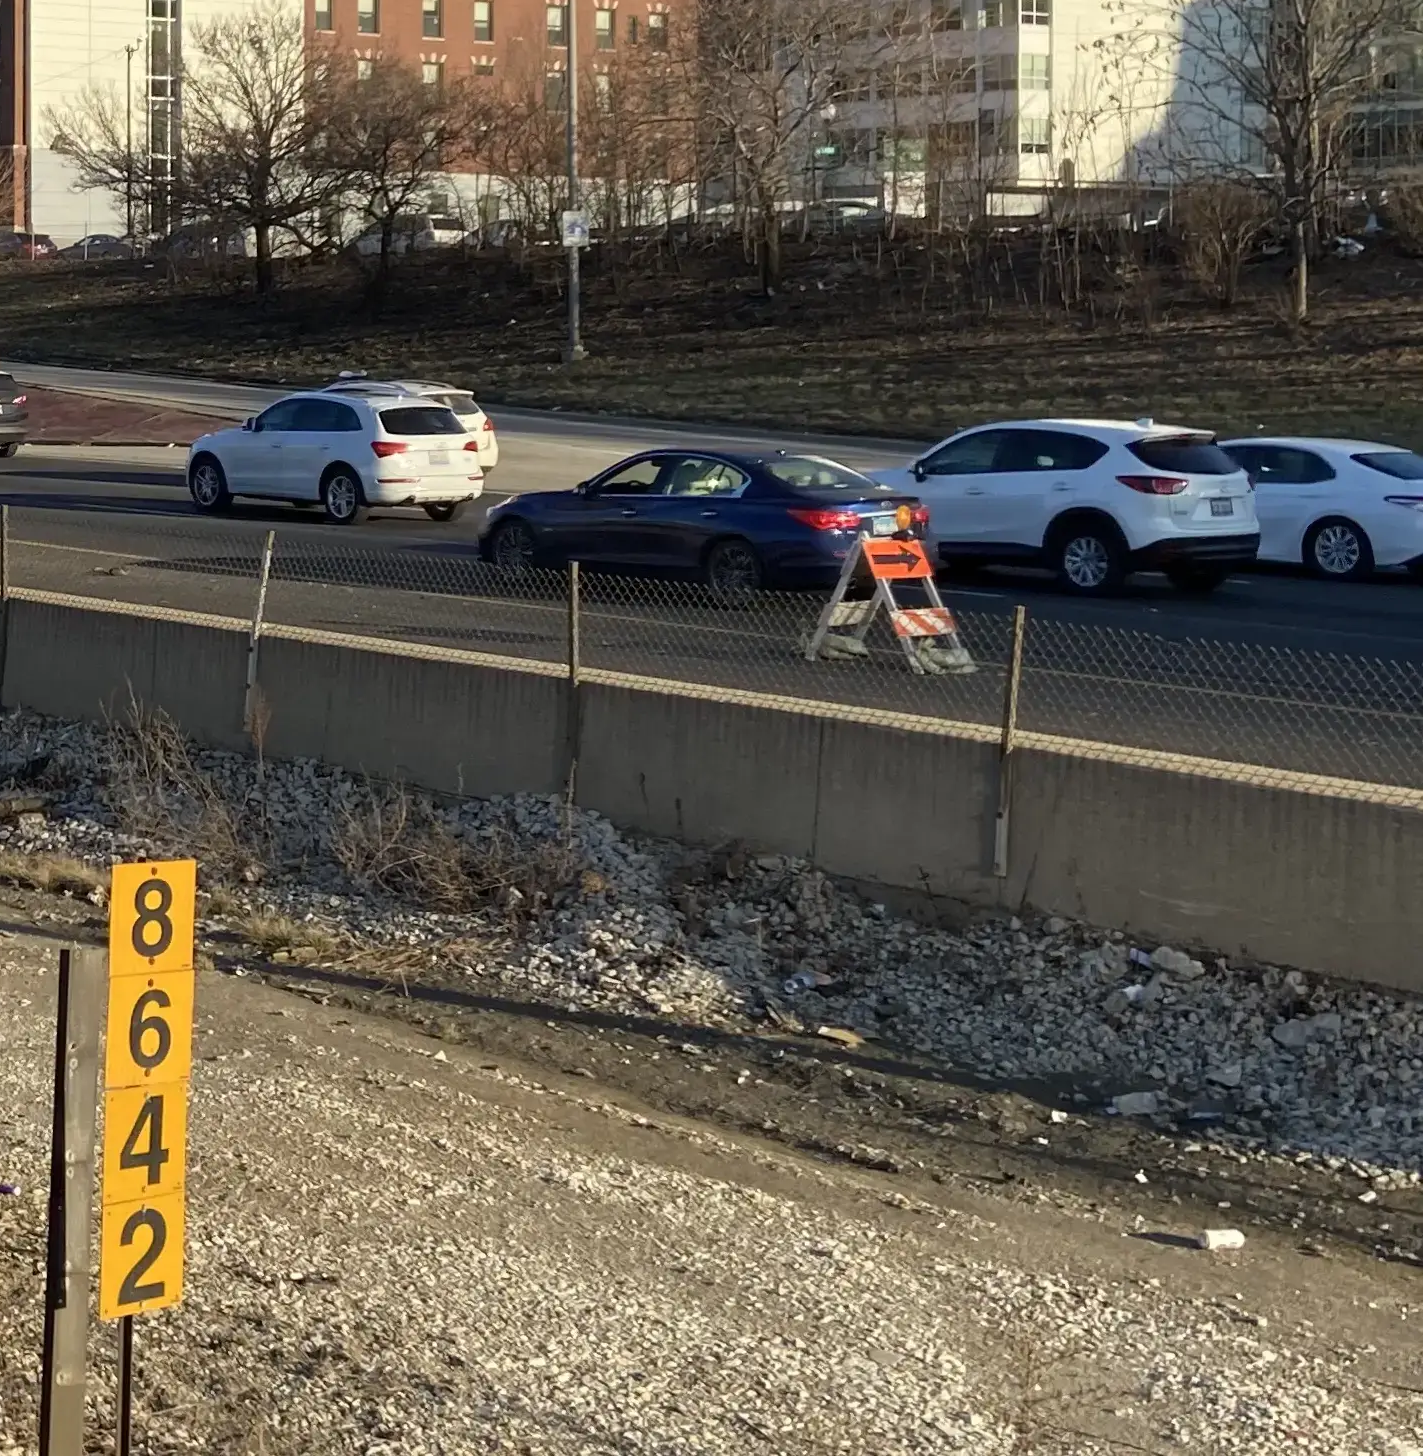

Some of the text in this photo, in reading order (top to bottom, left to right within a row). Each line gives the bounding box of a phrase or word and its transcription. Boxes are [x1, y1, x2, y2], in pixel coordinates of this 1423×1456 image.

[131, 878, 173, 958] 8
[129, 988, 172, 1069] 6
[119, 1094, 170, 1186] 4
[117, 1207, 167, 1307] 2
